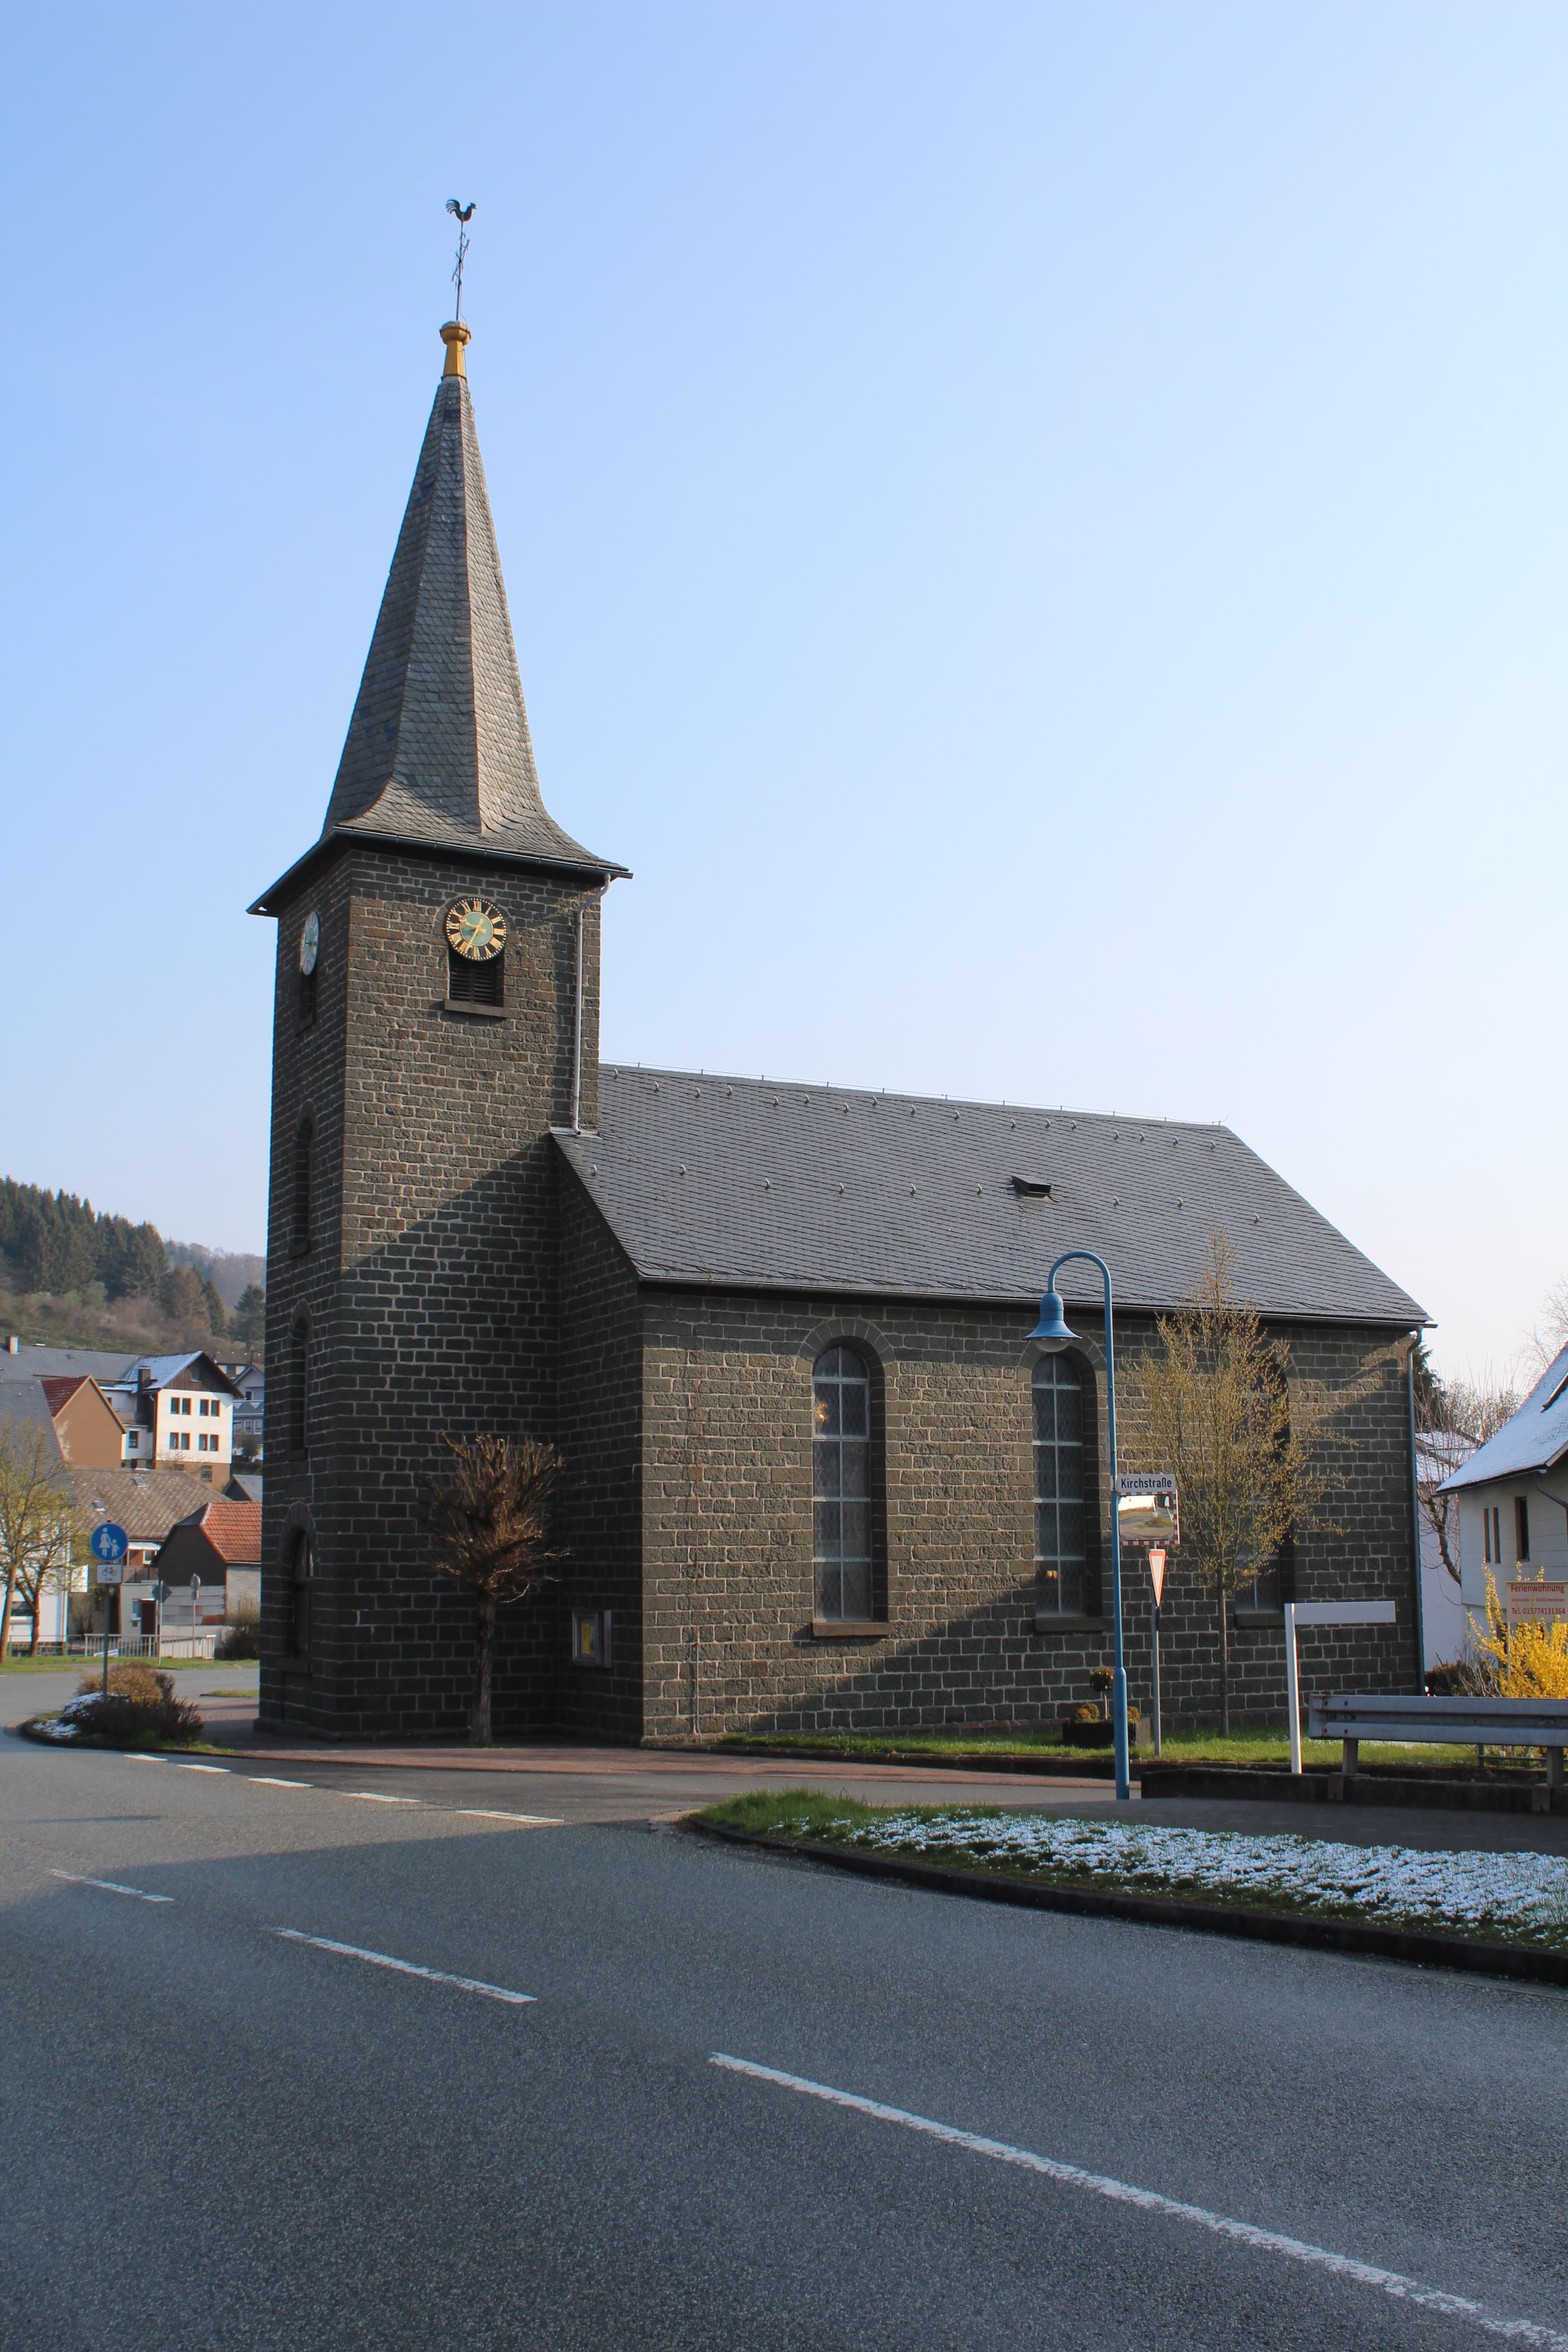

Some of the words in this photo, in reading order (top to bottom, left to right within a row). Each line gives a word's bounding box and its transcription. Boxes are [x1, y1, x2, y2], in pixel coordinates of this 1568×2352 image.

[461, 901, 471, 914] XI
[473, 900, 482, 912] XII
[485, 906, 492, 915] I
[491, 916, 501, 924] II
[1121, 1477, 1172, 1489] Kirchstraße
[1510, 1584, 1565, 1594] Ferienwohnung
